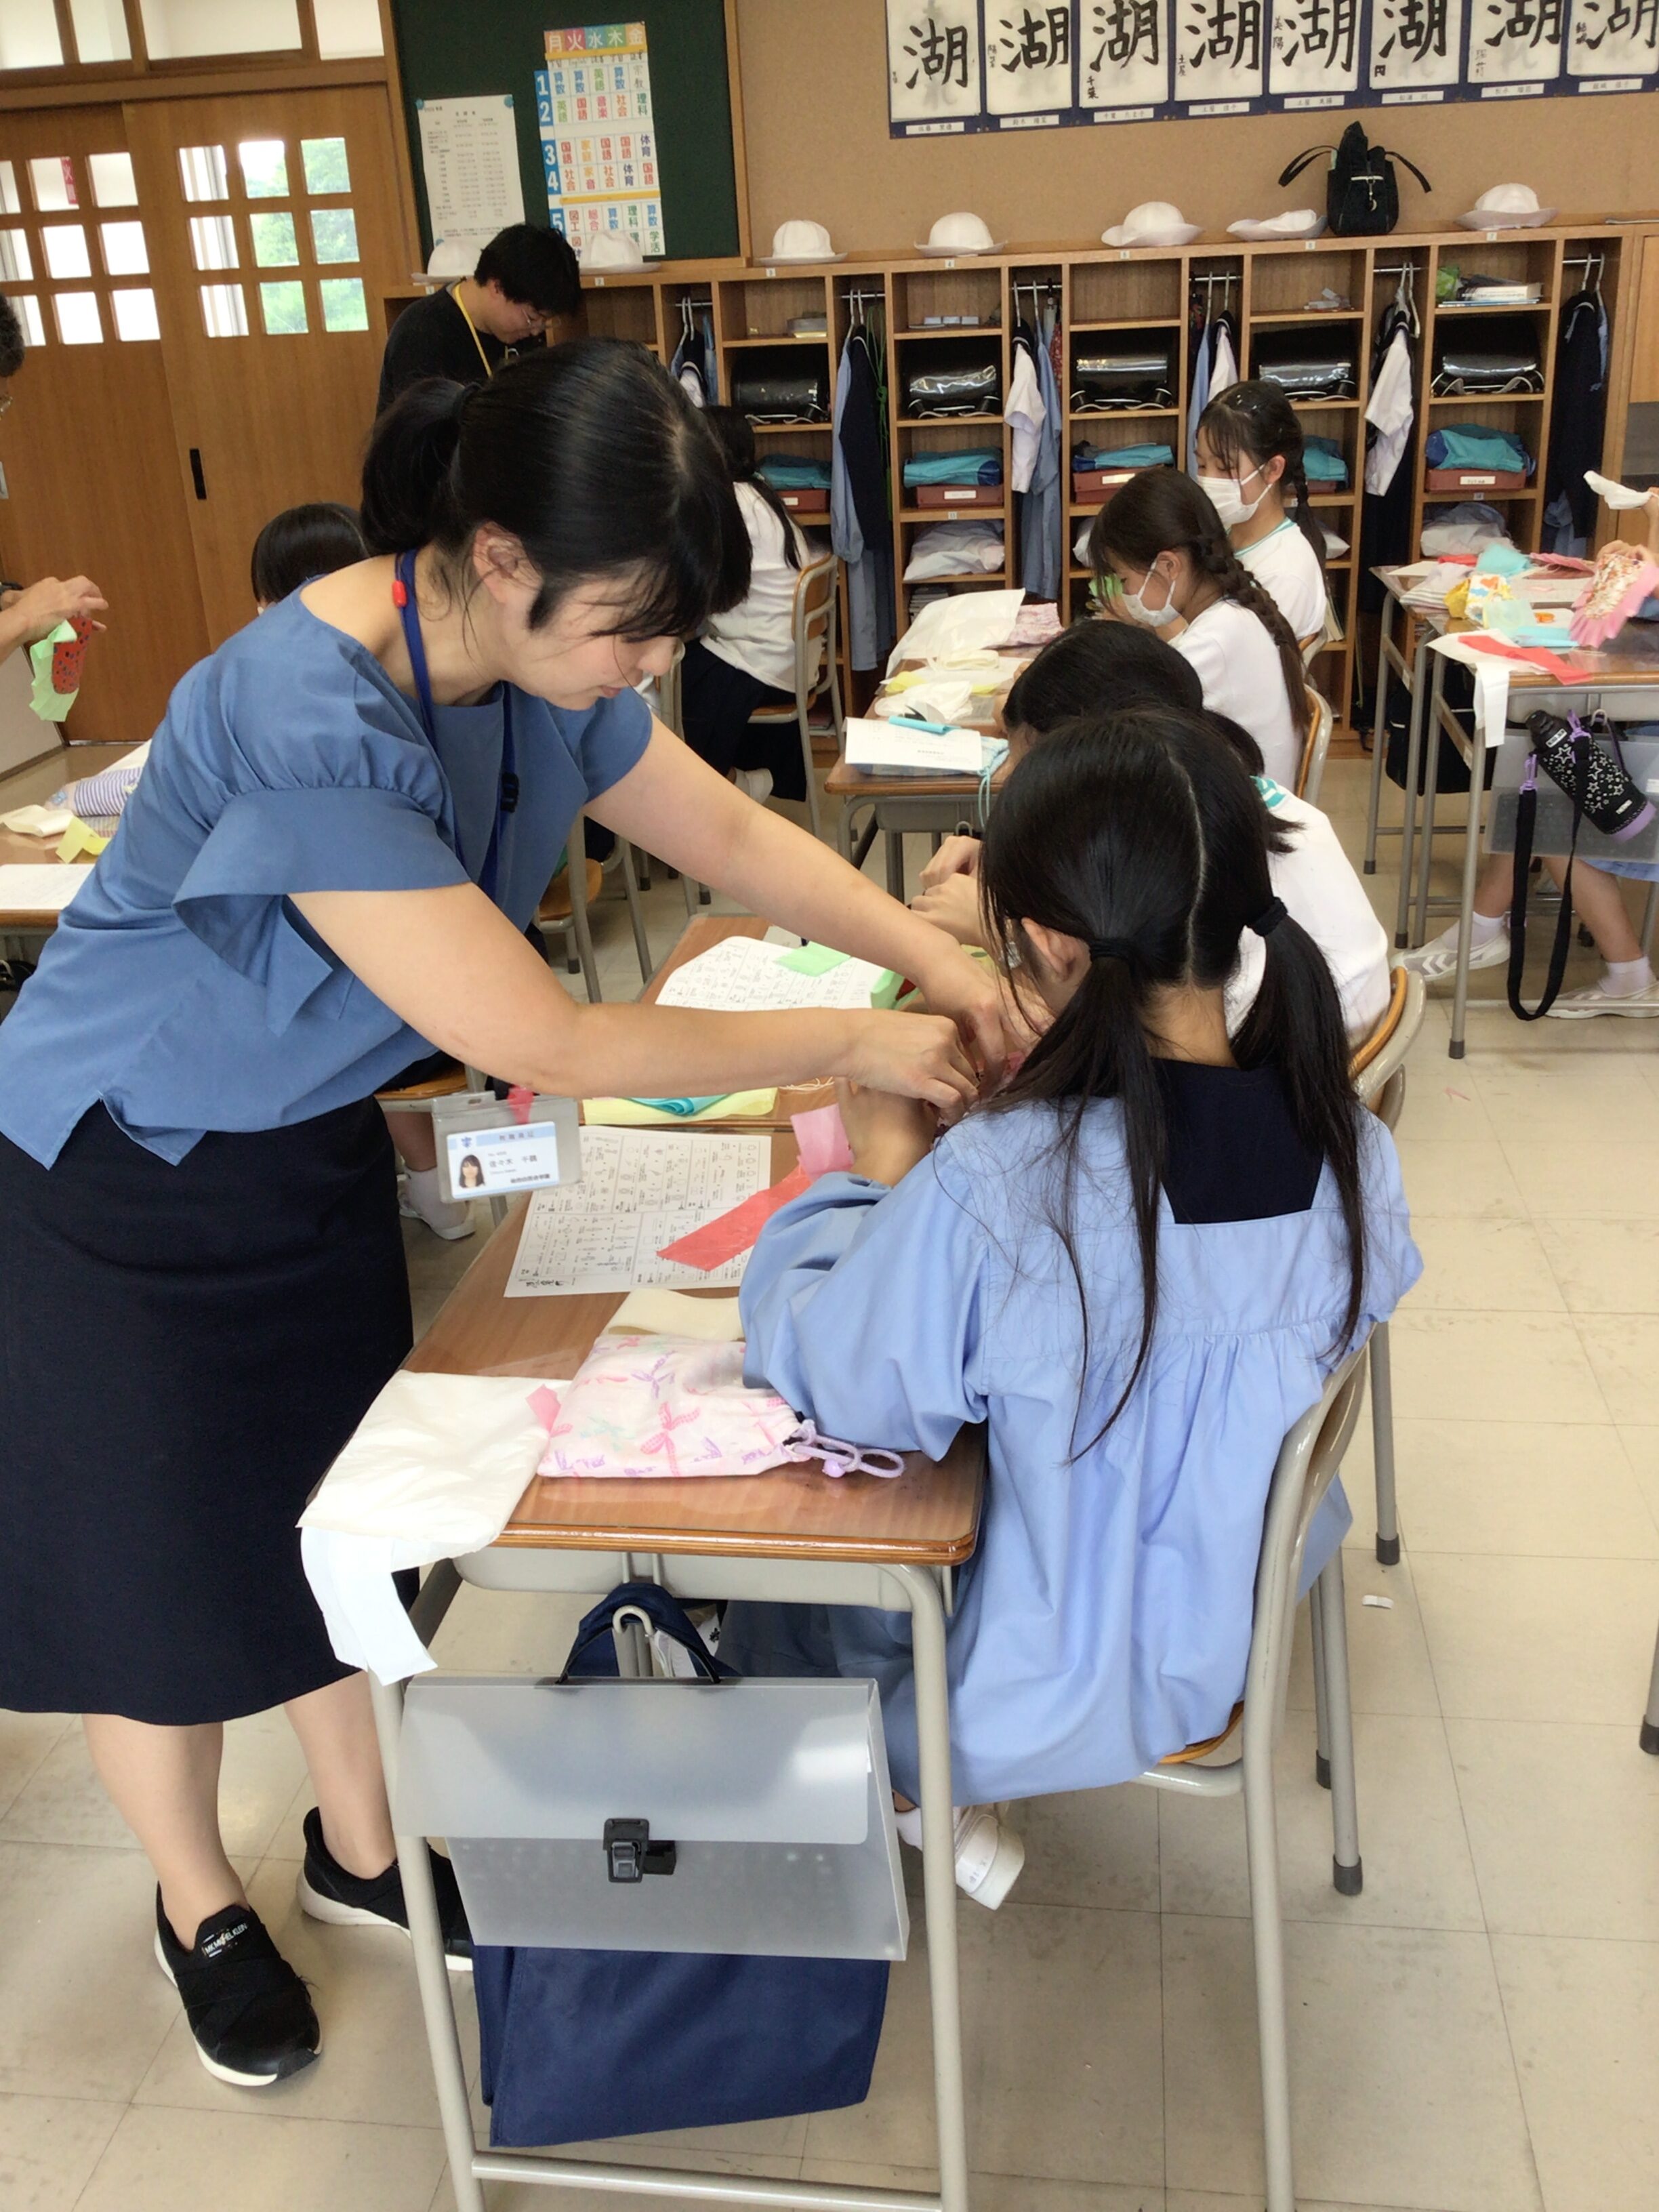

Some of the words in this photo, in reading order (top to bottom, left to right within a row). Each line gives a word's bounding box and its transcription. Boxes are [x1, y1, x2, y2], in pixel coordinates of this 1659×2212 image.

[549, 33, 562, 53] 月
[568, 32, 583, 51] 火
[589, 32, 603, 49] 水
[608, 30, 623, 47] 木
[629, 28, 643, 45] 金
[999, 7, 1069, 73] 湖
[1089, 0, 1159, 72] 湖
[1185, 0, 1261, 70] 湖
[1282, 0, 1356, 72] 湖
[1378, 0, 1447, 63] 湖
[903, 18, 968, 89] 湖
[537, 75, 548, 96] 1
[539, 101, 551, 122] 2
[577, 98, 587, 120] 国語
[617, 94, 627, 117] 社会
[637, 93, 647, 116] 理科
[544, 145, 556, 165] 3
[561, 141, 572, 164] 国語
[600, 138, 612, 161] 国語
[621, 136, 632, 159] 国語
[640, 134, 651, 157] 体育
[547, 171, 558, 191] 4
[565, 169, 575, 191] 社会
[604, 165, 615, 188] 社会
[623, 163, 634, 186] 体育
[643, 162, 654, 185] 国語
[552, 213, 563, 234] 5
[569, 209, 579, 232] 図工
[608, 207, 618, 230] 算数
[628, 205, 638, 227] 理科
[647, 204, 657, 226] 算数
[650, 230, 660, 253] 学活
